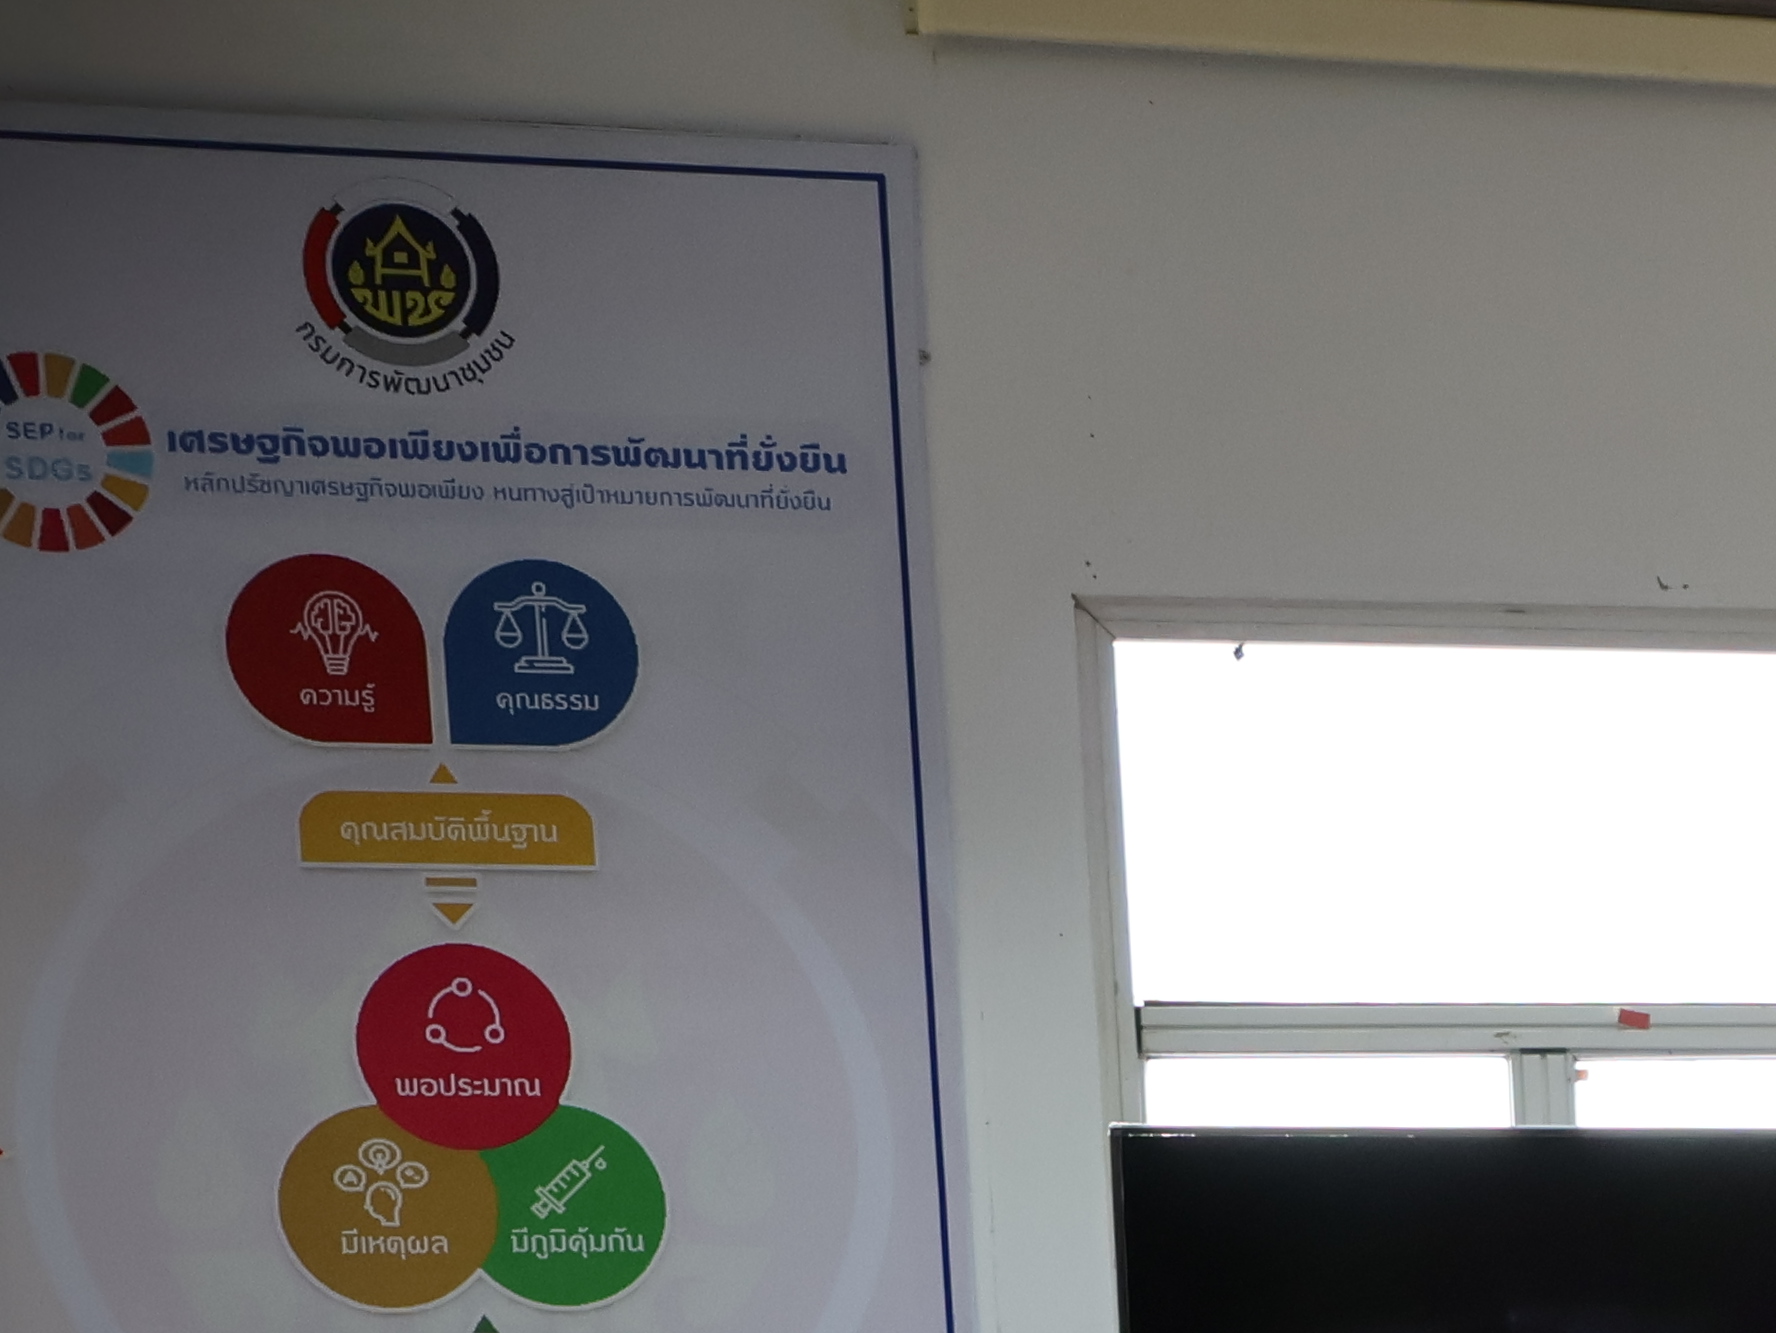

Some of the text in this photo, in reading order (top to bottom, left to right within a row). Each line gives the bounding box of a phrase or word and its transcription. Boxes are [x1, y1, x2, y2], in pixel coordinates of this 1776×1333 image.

[295, 318, 518, 396] กรมการพัฒนาชุมชน
[5, 418, 55, 441] SEP
[167, 424, 849, 476] เศรษฐกิจพอเพียงเพื่อการพัฒนาที่ยั่งยืน
[4, 455, 93, 483] SDGs
[184, 472, 832, 516] หลักปรัชญาเศรษฐกิจพอเพียง หนทางสู่เป้าหมายการพัฒนาที่ยั่งยืน
[299, 685, 377, 713] ความรู้
[496, 688, 600, 718] คุณธรรม
[339, 810, 559, 848] คุณสมบัติพื้นฐาน
[394, 1073, 541, 1099] พอประมาณ
[340, 1228, 450, 1260] มีเหตุผล
[510, 1226, 646, 1261] มีภูมิคุ้มกัน
